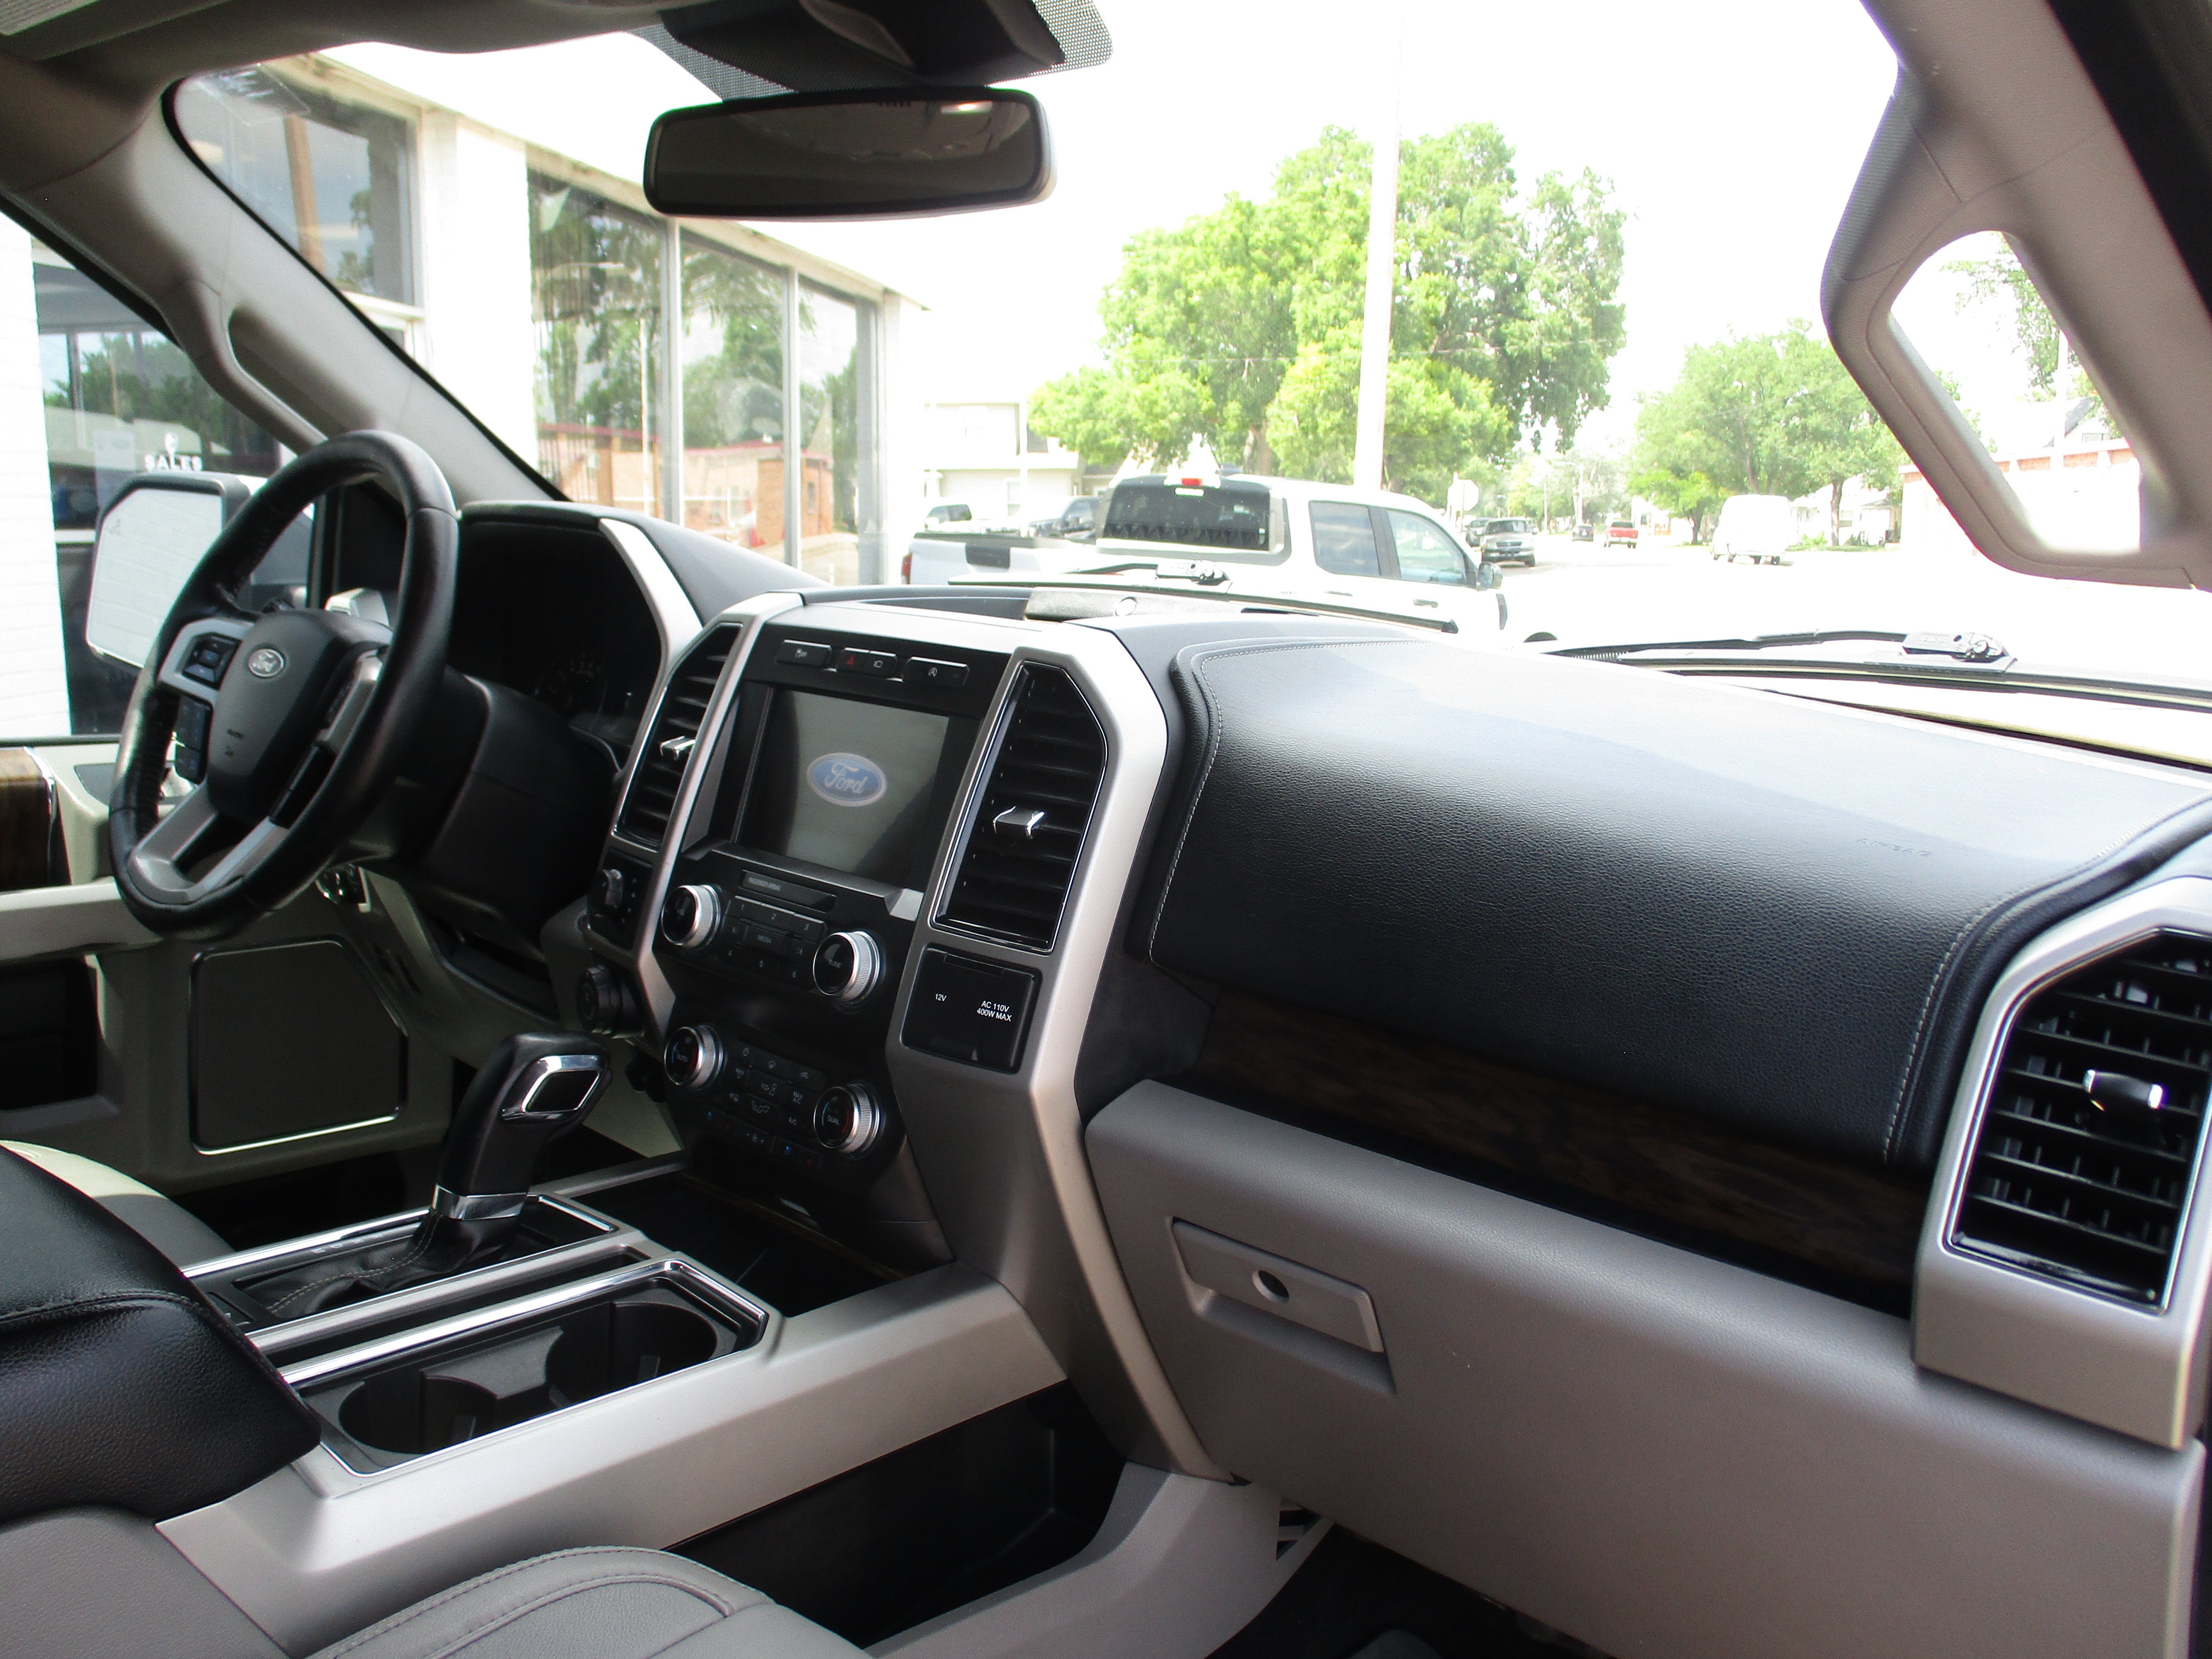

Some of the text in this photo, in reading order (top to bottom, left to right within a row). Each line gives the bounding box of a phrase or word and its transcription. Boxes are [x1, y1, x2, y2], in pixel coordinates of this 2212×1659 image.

[144, 454, 202, 471] SALES
[824, 763, 869, 794] Ford
[935, 994, 947, 1002] 12V
[993, 1003, 1009, 1012] 110V
[976, 1008, 1012, 1022] 400W MAX
[793, 1091, 803, 1100] MAX
[788, 1117, 797, 1125] A/C
[828, 1115, 840, 1125] DUAL
